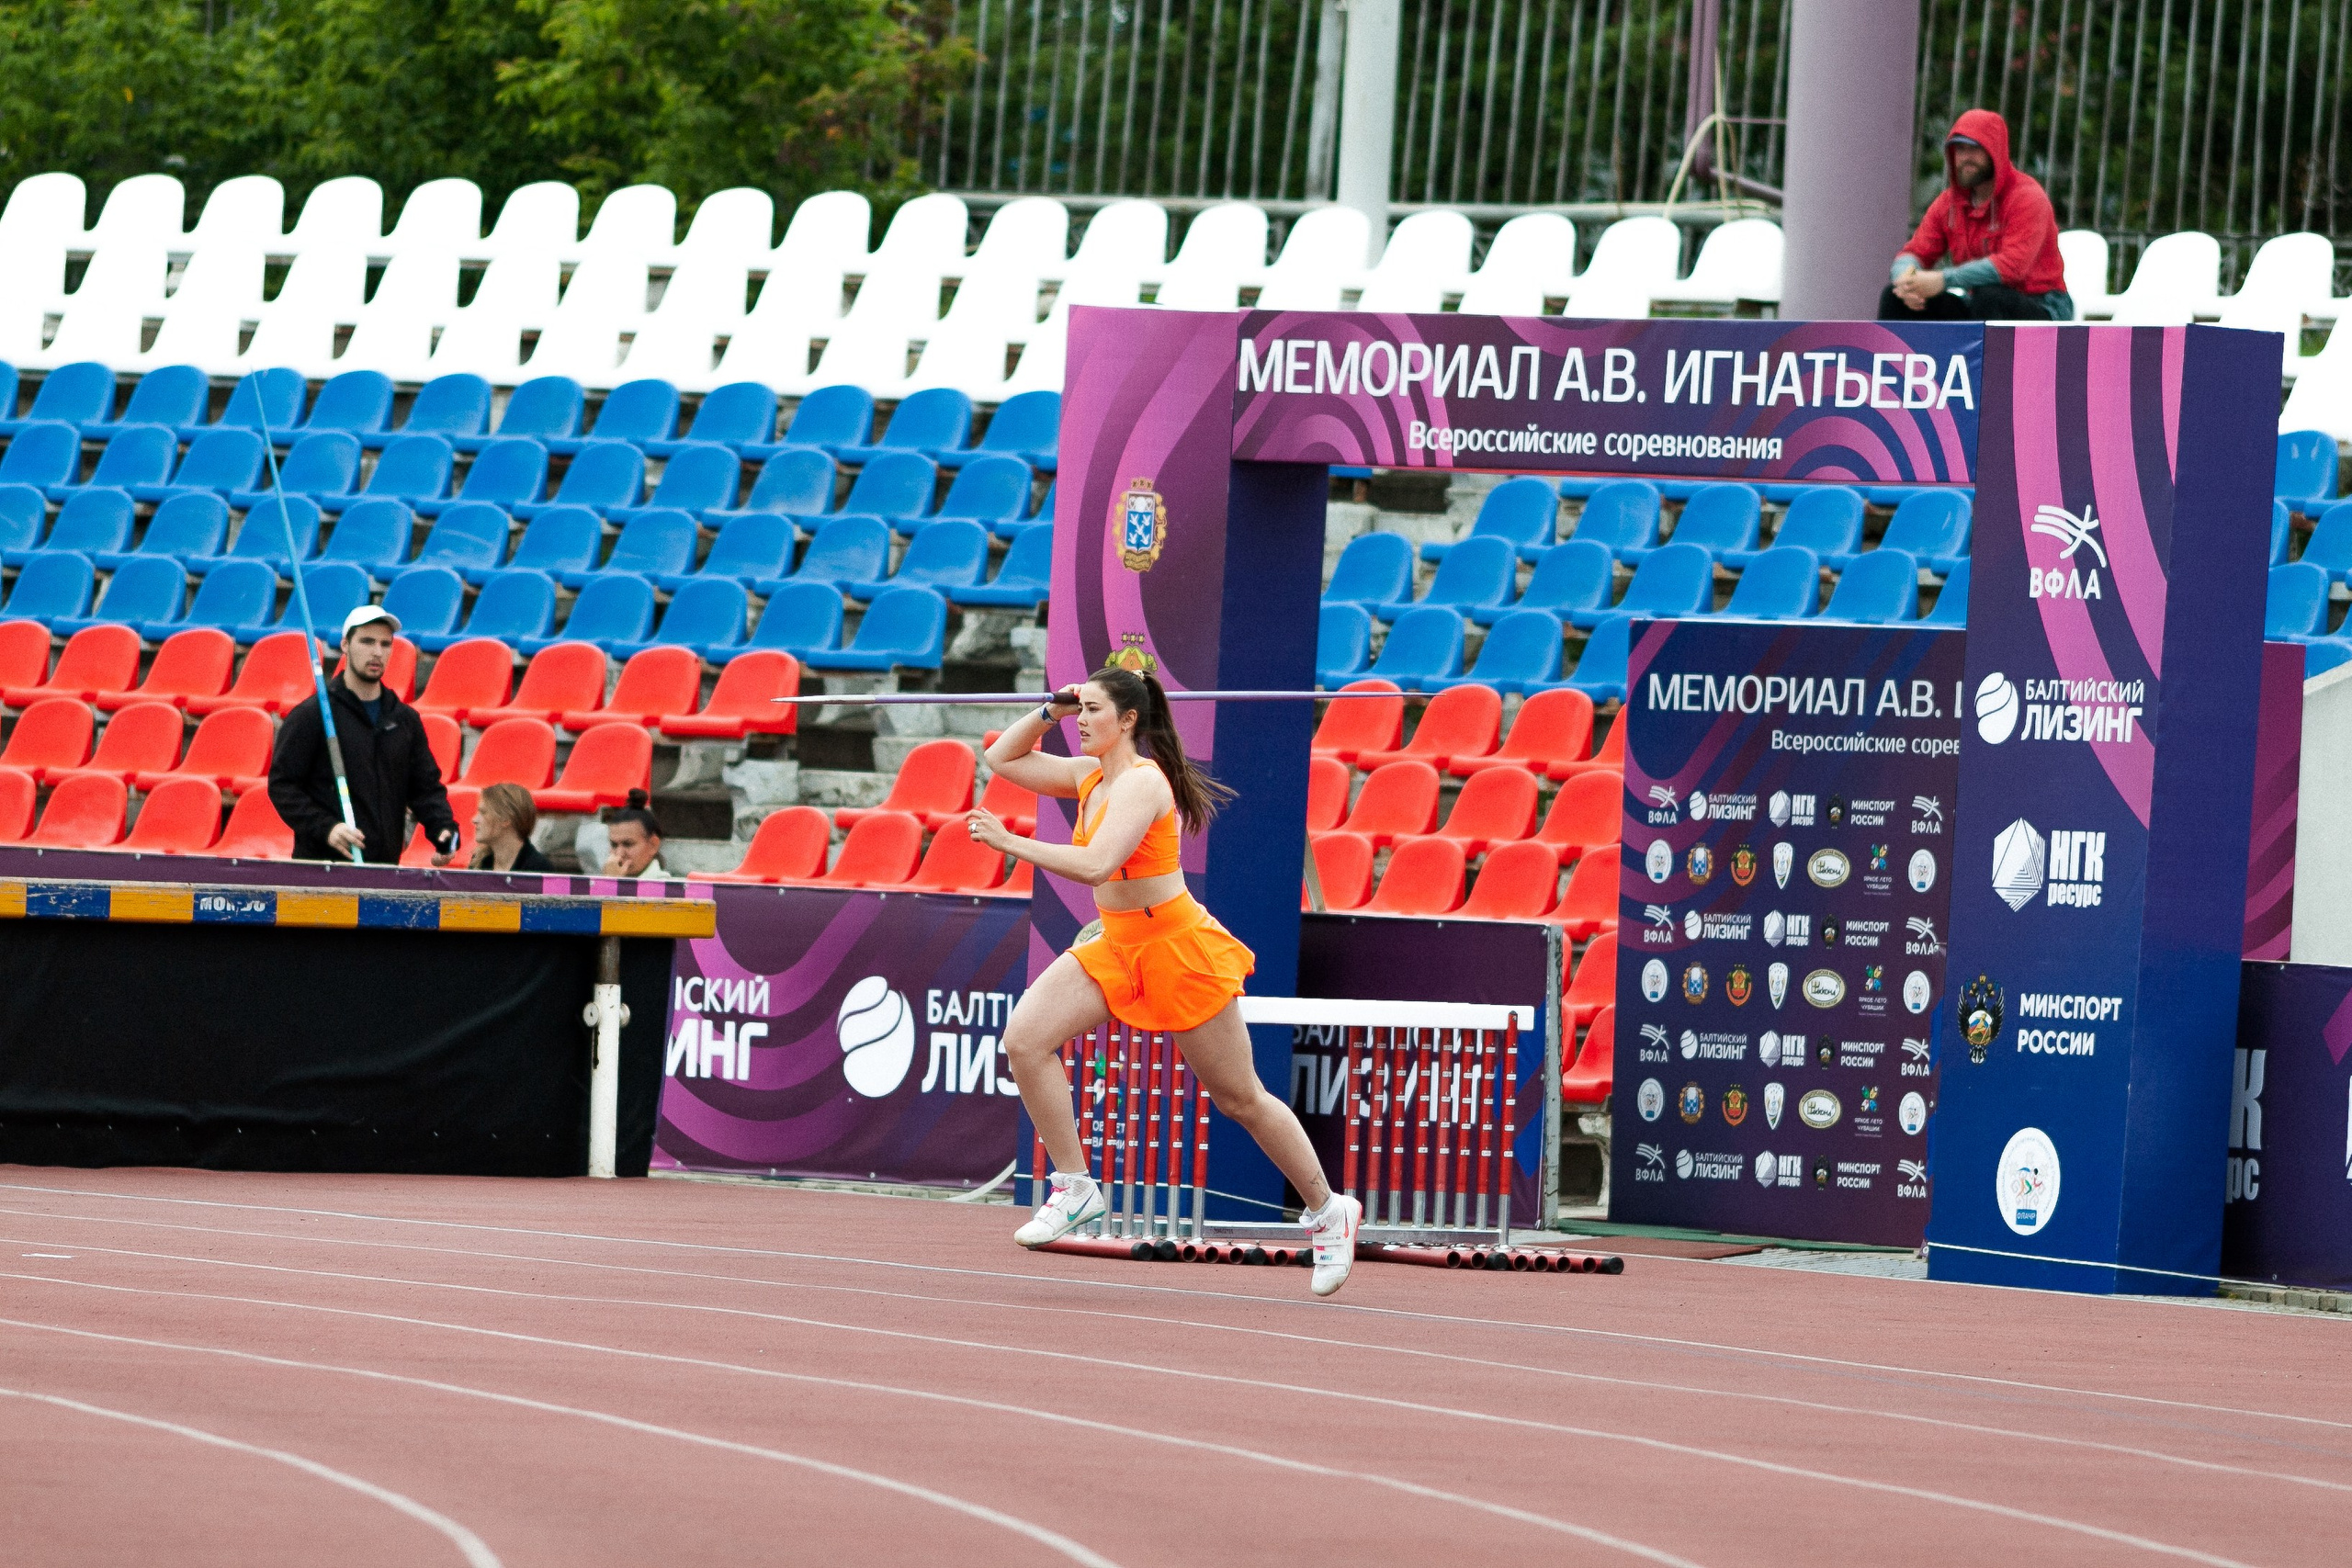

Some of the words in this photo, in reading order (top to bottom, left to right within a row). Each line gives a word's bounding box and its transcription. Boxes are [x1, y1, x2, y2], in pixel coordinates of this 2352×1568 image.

[1237, 338, 1539, 401] МЕМОРИАЛ
[1555, 346, 1646, 404] А.В.
[1663, 351, 1974, 411] ИГНАТЬЕВА
[1408, 420, 1597, 457] Всероссийские
[1603, 430, 1782, 462] соревнования
[2029, 568, 2102, 600] ВФЛА
[1648, 673, 1866, 716] МЕМОРИАЛ
[1875, 680, 1941, 718] А.В.
[2025, 677, 2144, 704] БАЛТИЙСКИЙ
[2020, 705, 2143, 743] ЛИЗИНГ
[1771, 729, 1906, 754] Всероссийские
[1709, 794, 1757, 806] БАЛТИЙСКИЙ
[1792, 795, 1816, 817] НГК
[1851, 799, 1895, 812] МИНСПОРТ
[1648, 811, 1677, 824] ВФЛА
[1708, 803, 1756, 819] ЛИЗИНГ
[1850, 814, 1884, 826] РОССИИ
[1911, 820, 1941, 834] ВФЛА
[2050, 829, 2106, 882] НГК
[2047, 881, 2102, 908] ресурс
[1703, 913, 1751, 924] БАЛТИЙСКИЙ
[1787, 915, 1810, 937] НГК
[1702, 922, 1751, 940] ЛИЗИНГ
[1846, 920, 1889, 933] МИНСПОРТ
[1644, 930, 1672, 943] ВФЛА
[1845, 935, 1879, 947] РОССИИ
[1905, 942, 1933, 955] ВФЛА
[926, 989, 1012, 1027] БАЛТ
[2019, 993, 2122, 1021] МИНСПОРТ
[1700, 1032, 1747, 1043] БАЛТИЙСКИЙ
[2017, 1029, 2096, 1056] РОССИИ
[1699, 1043, 1747, 1059] ЛИЗИНГ
[1782, 1035, 1806, 1056] НГК
[1841, 1041, 1885, 1055] МИНСПОРТ
[1640, 1049, 1668, 1063] ВФЛА
[1840, 1055, 1874, 1067] РОССИИ
[1901, 1063, 1929, 1077] ВФЛА
[1695, 1153, 1743, 1164] БАЛТИЙСКИЙ
[1778, 1155, 1802, 1177] НГК
[1635, 1168, 1664, 1182] ВФЛА
[1694, 1162, 1743, 1179] ЛИЗИНГ
[1837, 1162, 1881, 1175] МИНСПОРТ
[1837, 1176, 1871, 1188] РОССИИ
[1897, 1184, 1927, 1198] ВФЛА
